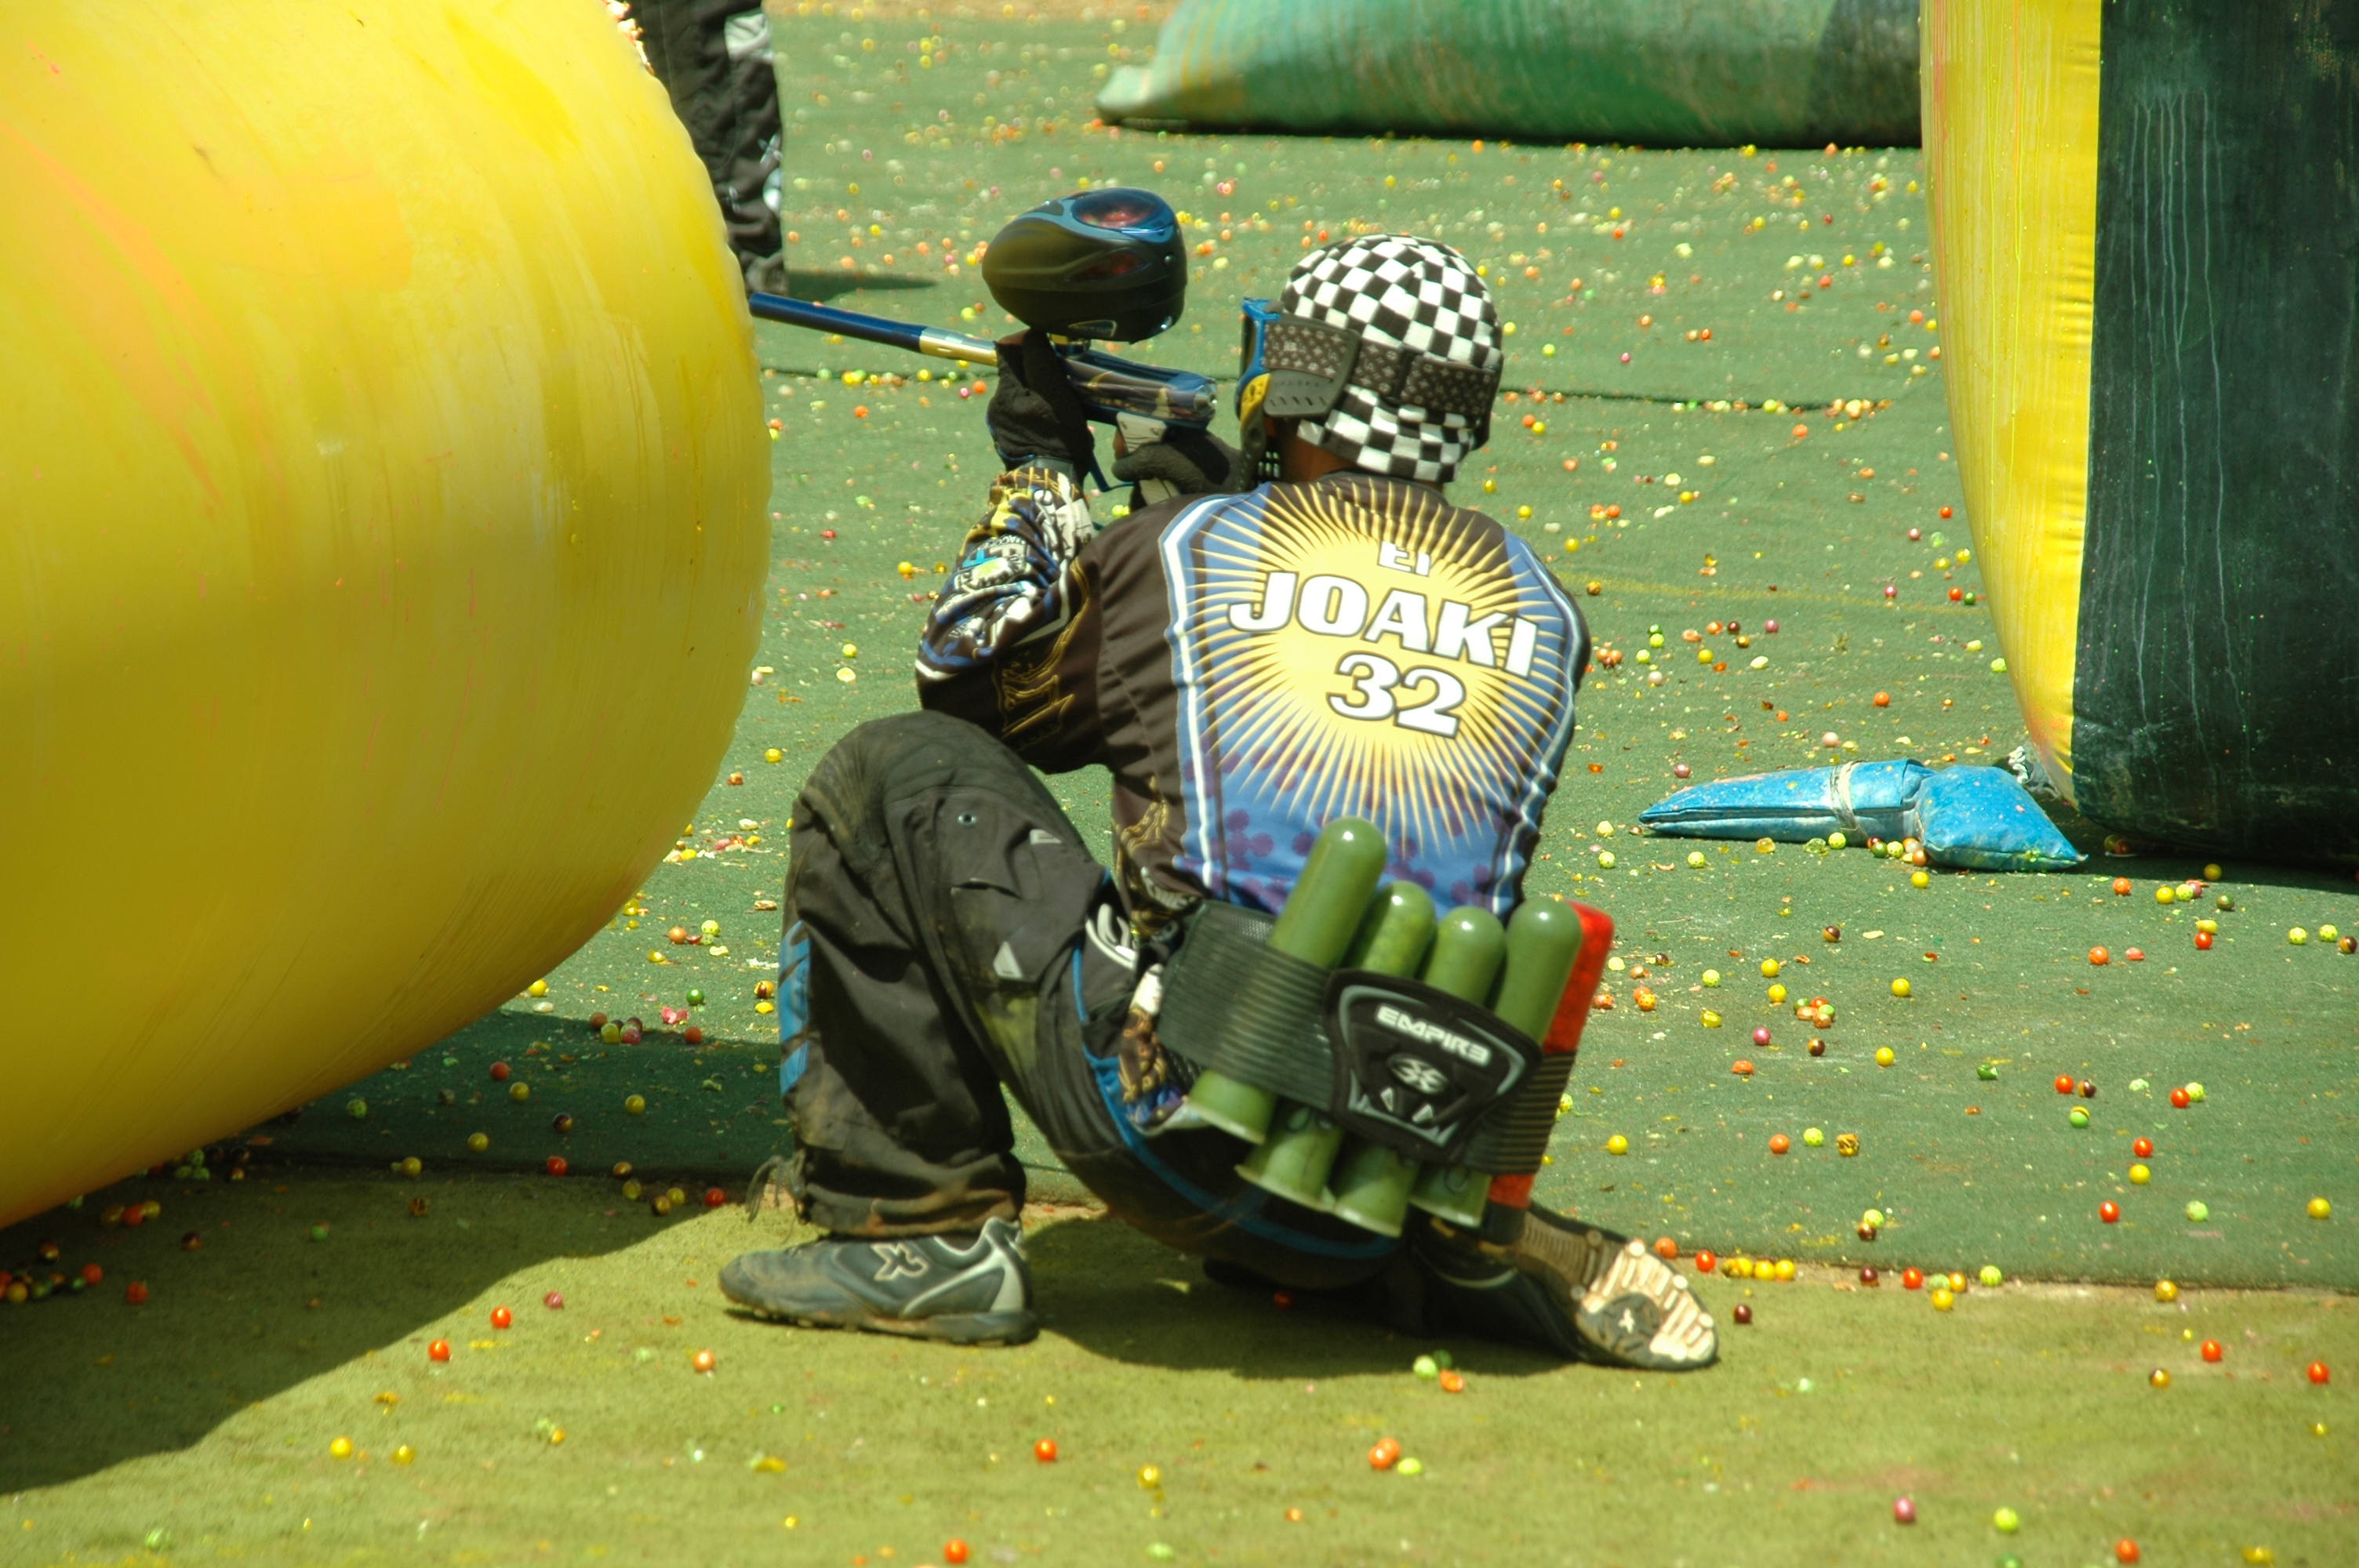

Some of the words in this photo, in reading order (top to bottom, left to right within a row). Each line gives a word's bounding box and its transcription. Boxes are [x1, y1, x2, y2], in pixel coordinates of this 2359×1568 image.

[1228, 571, 1538, 679] JOAKI
[1326, 652, 1467, 740] 32
[1376, 1004, 1490, 1068] EMPIRE
